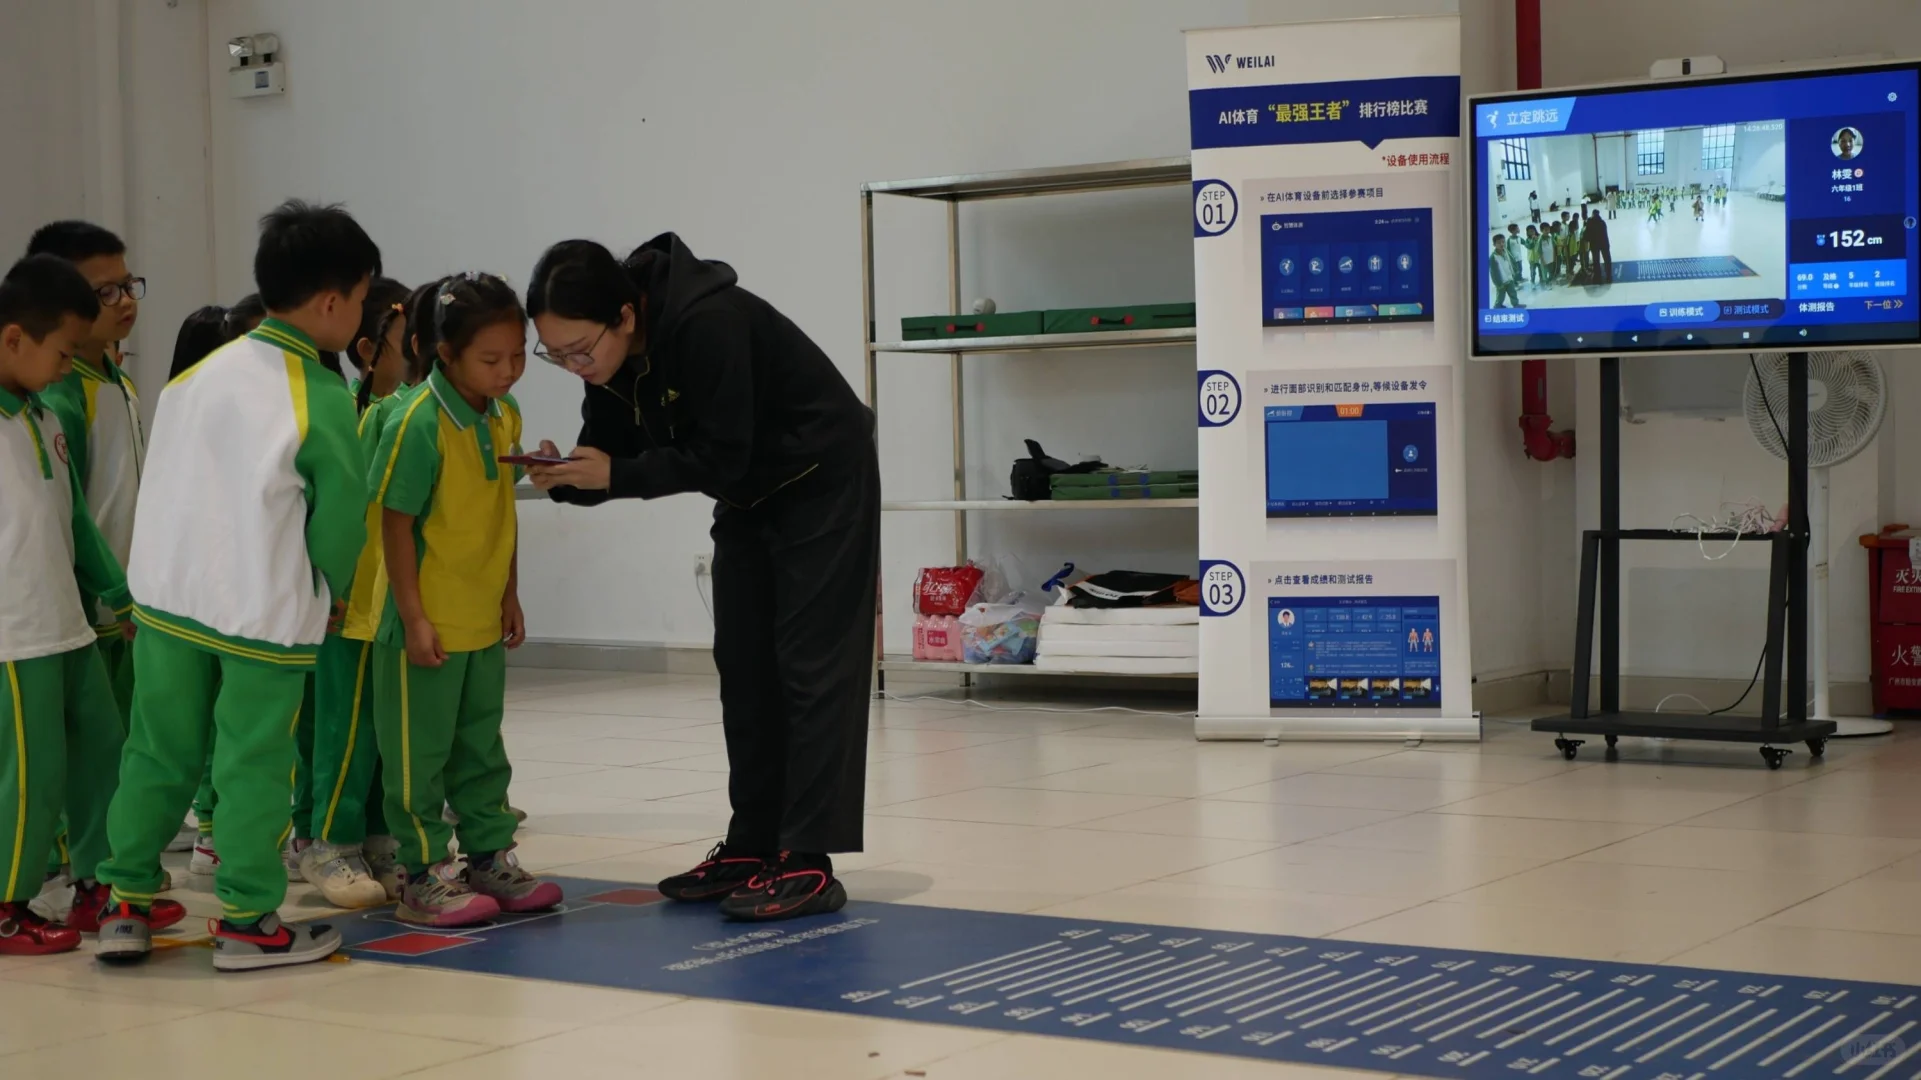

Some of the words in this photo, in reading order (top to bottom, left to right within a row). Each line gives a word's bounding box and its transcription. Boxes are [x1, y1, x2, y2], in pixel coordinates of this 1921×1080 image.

[1236, 55, 1275, 69] WEILAI
[1218, 108, 1259, 125] AI体育
[1359, 99, 1428, 119] 排行榜比赛
[1506, 108, 1559, 126] 立定跳远
[1267, 187, 1384, 203] 在AI体育设备前选择参赛项目
[1831, 183, 1864, 193] 六年级1班
[1202, 190, 1226, 201] STEP
[1202, 203, 1226, 226] 01
[1829, 229, 1866, 248] 152
[1867, 234, 1883, 245] cm
[1848, 271, 1854, 279] 5
[1874, 270, 1880, 278] 2
[1492, 312, 1525, 324] 结束测试
[1668, 306, 1704, 318] 训练模式
[1733, 304, 1770, 315] 测试模式
[1799, 301, 1835, 313] 体测报告
[1864, 299, 1892, 310] 下一位
[1206, 381, 1229, 392] STEP
[1206, 393, 1230, 416] 02
[1340, 406, 1359, 415] 01:00
[1209, 571, 1233, 582] STEP
[1274, 574, 1374, 585] 点击查看成绩和测试报告
[1209, 583, 1234, 606] 03
[1892, 585, 1905, 593] FIRE
